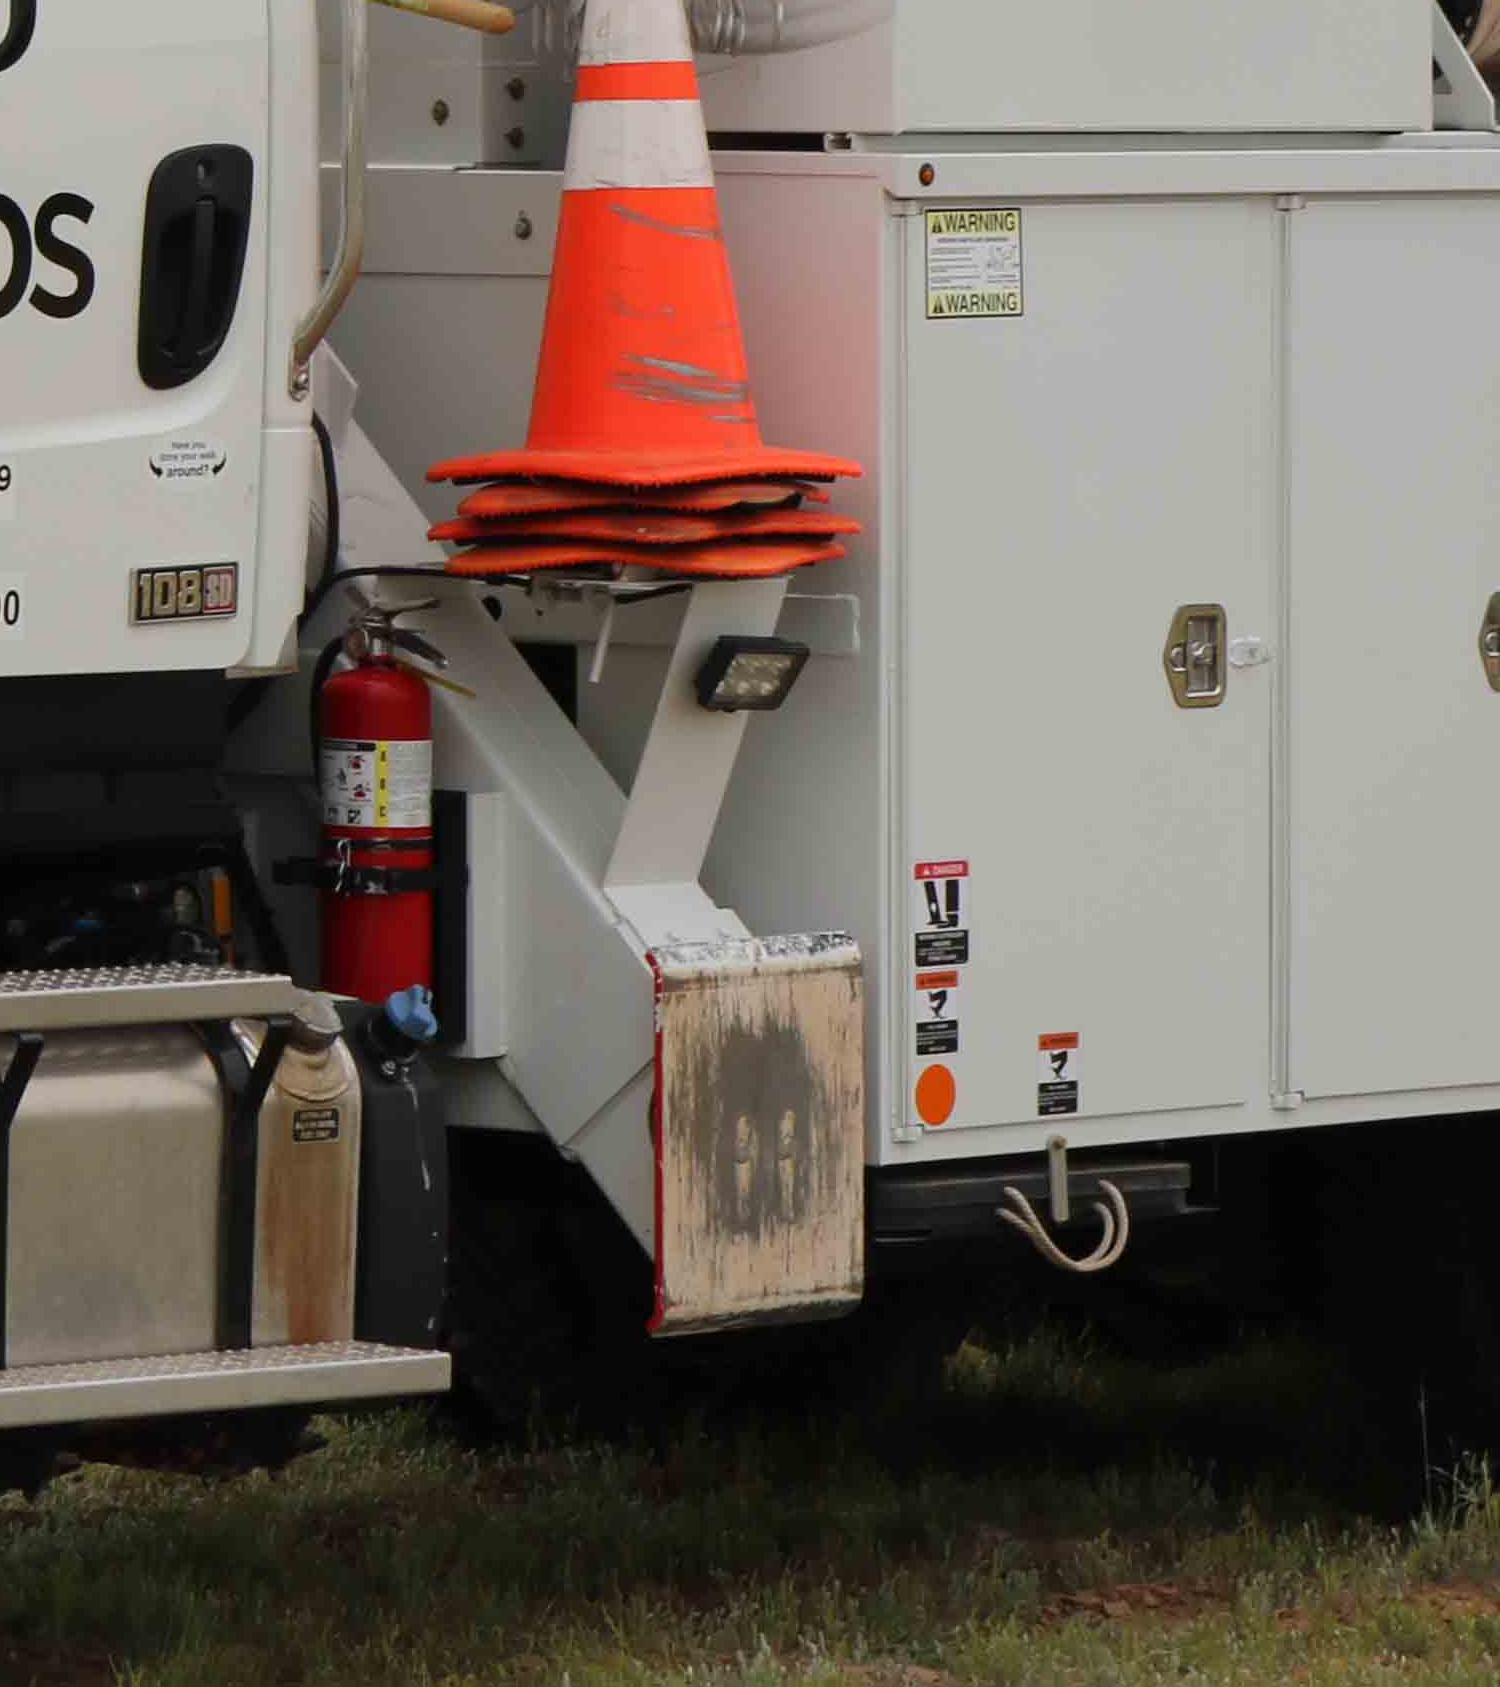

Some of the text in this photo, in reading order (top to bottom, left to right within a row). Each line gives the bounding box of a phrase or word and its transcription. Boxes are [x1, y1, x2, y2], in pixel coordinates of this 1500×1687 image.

[944, 212, 1016, 233] WARNING
[946, 292, 1018, 313] WARNING
[139, 569, 202, 618] 108
